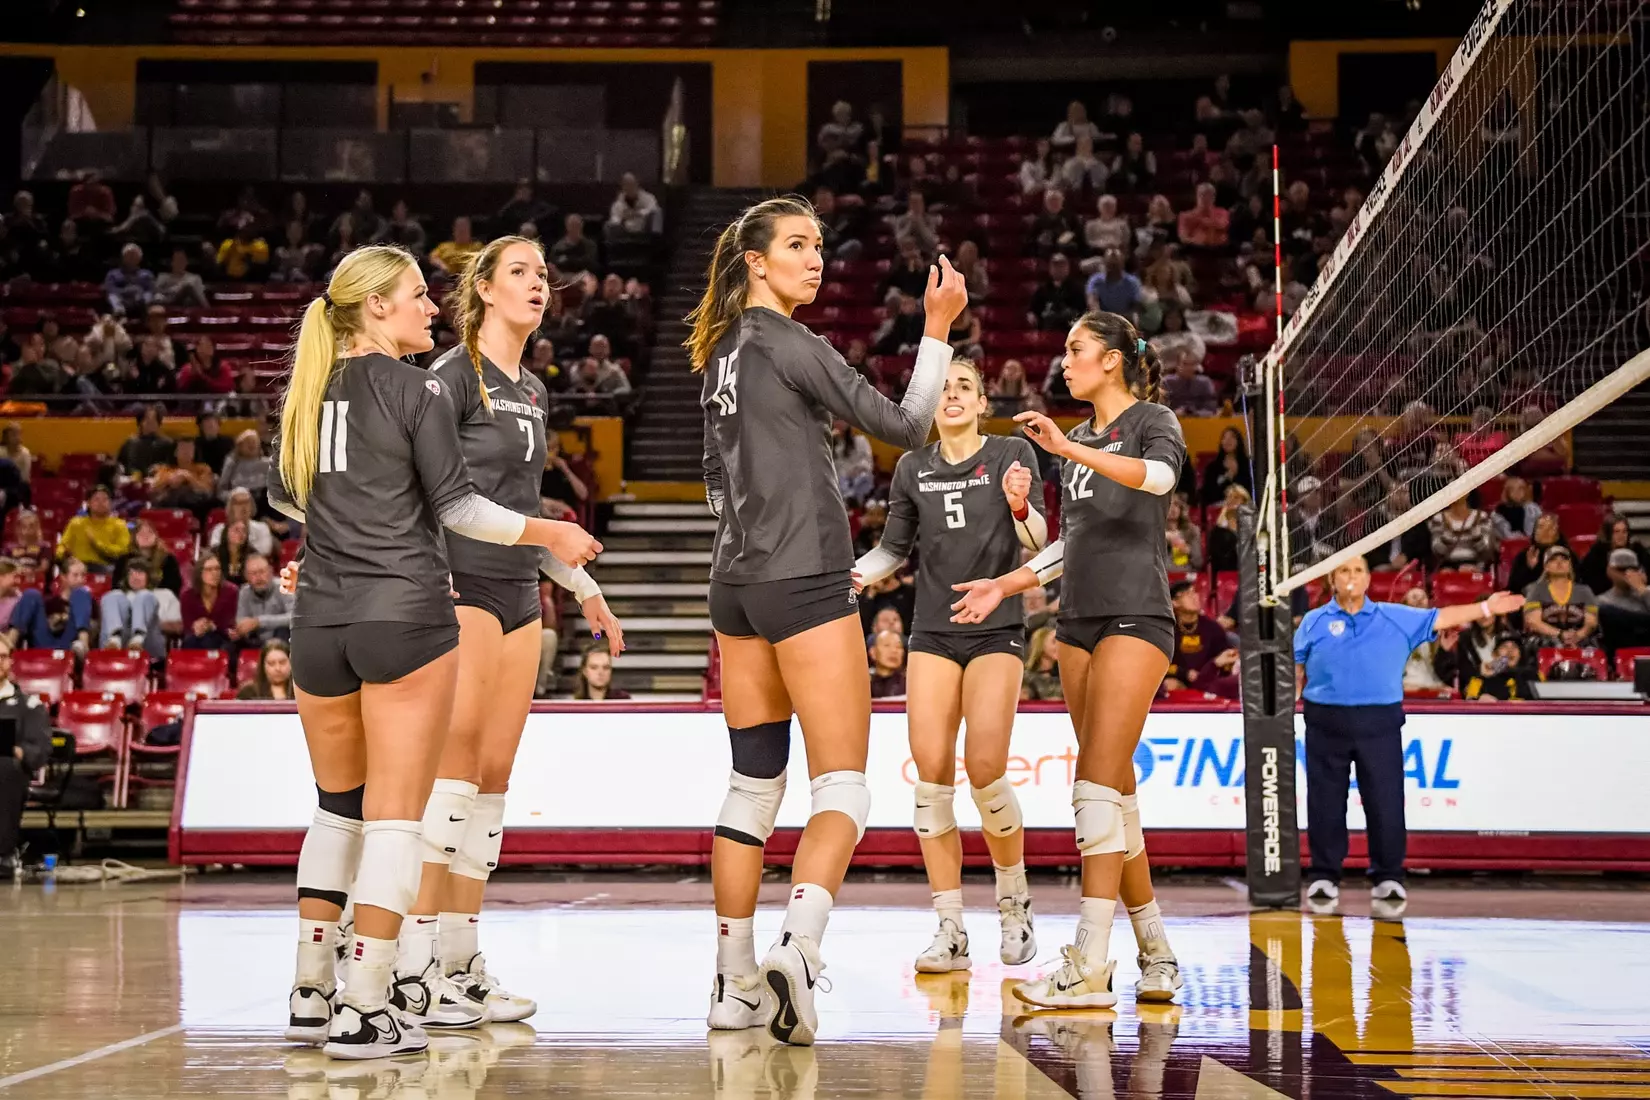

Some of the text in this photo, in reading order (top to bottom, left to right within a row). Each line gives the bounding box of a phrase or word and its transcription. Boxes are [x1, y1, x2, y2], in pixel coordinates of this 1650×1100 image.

[712, 347, 739, 416] 15
[320, 401, 350, 473] 11
[516, 418, 535, 462] 7
[919, 474, 991, 493] WASHINGTON STATE
[1068, 463, 1095, 502] 12
[944, 491, 966, 529] 5
[1146, 738, 1460, 789] FINAL
